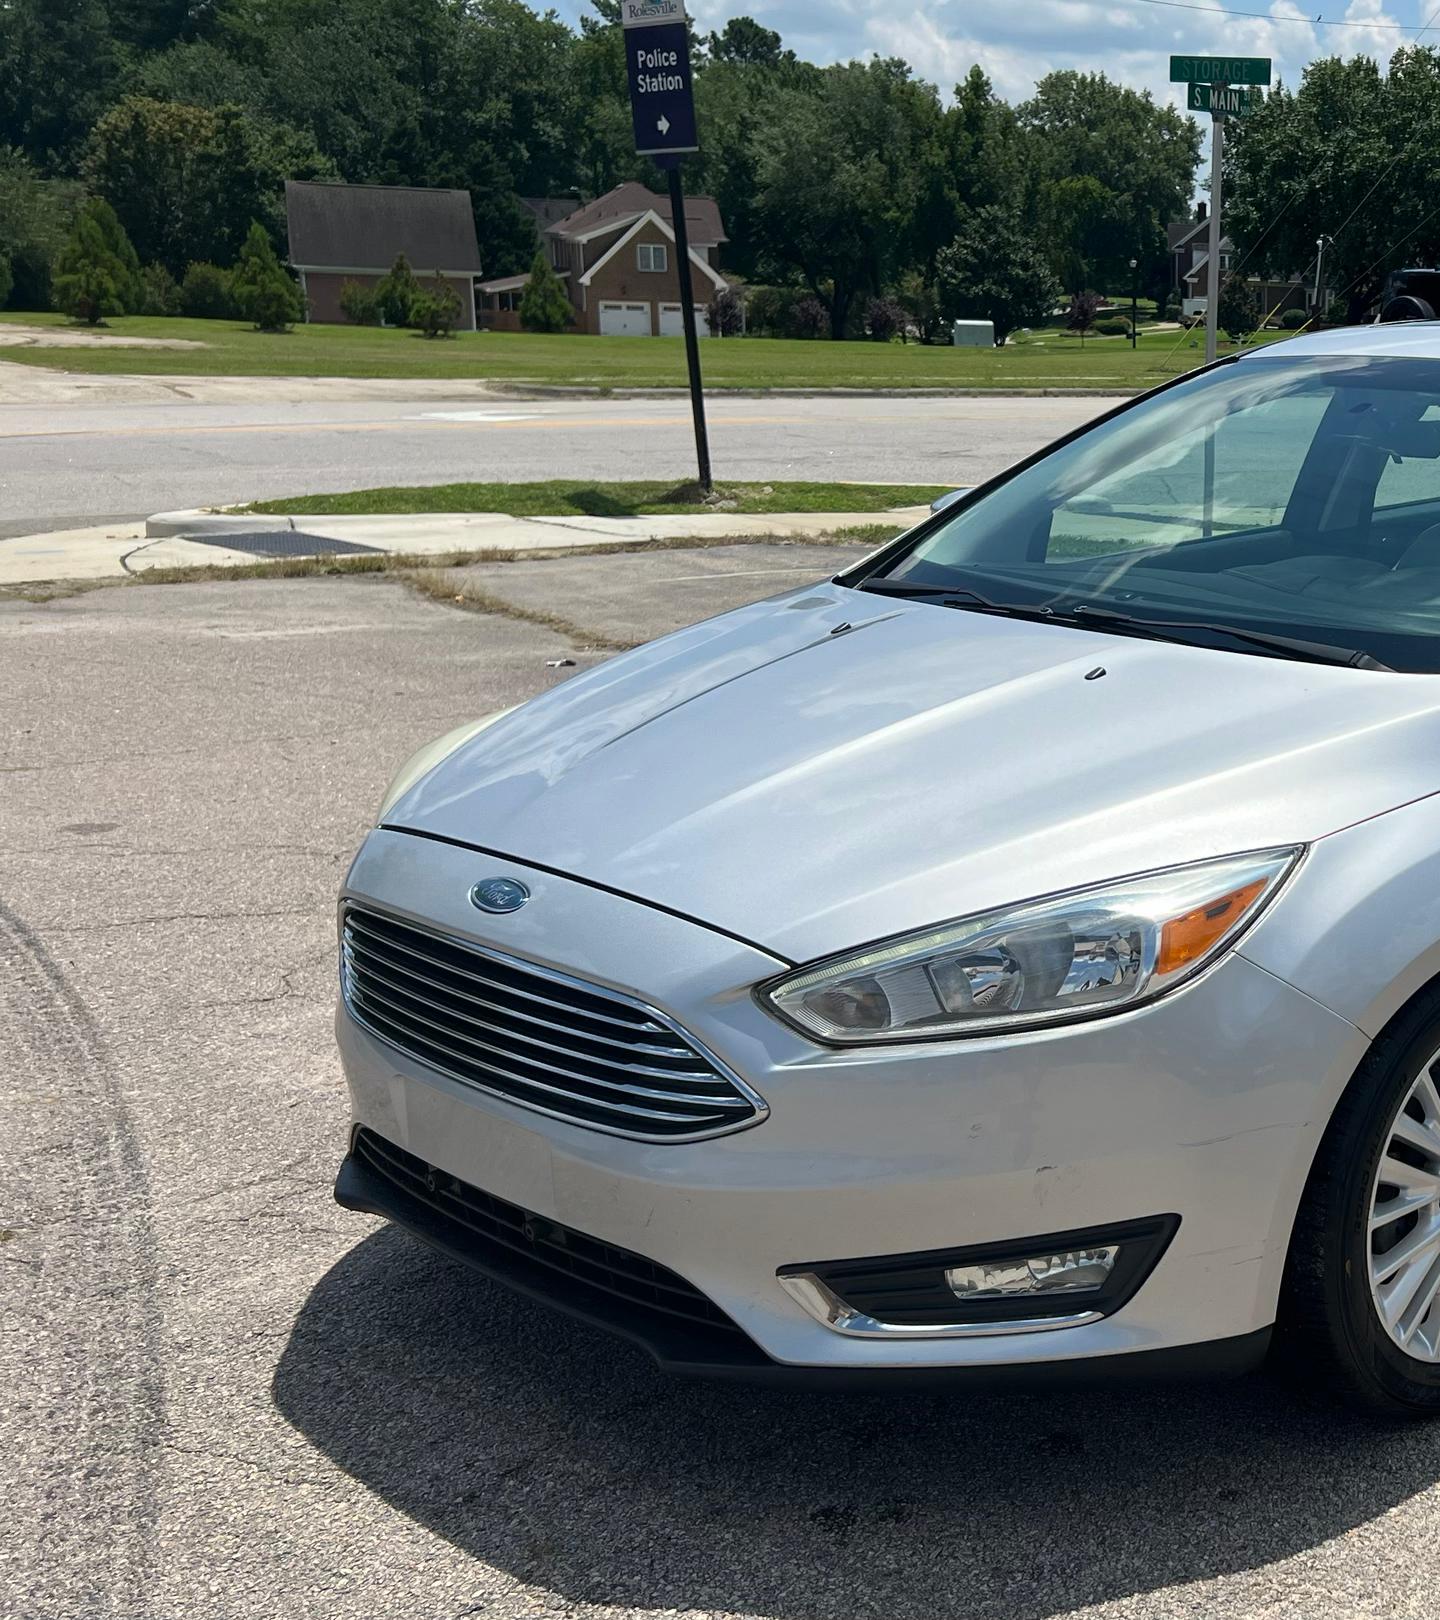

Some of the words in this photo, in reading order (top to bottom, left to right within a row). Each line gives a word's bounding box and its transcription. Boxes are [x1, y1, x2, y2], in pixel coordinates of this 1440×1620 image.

[629, 2, 677, 18] Rolesville
[637, 48, 678, 69] Police
[1182, 60, 1251, 81] STORAGE
[637, 72, 684, 93] Station
[1209, 89, 1239, 111] MAIN
